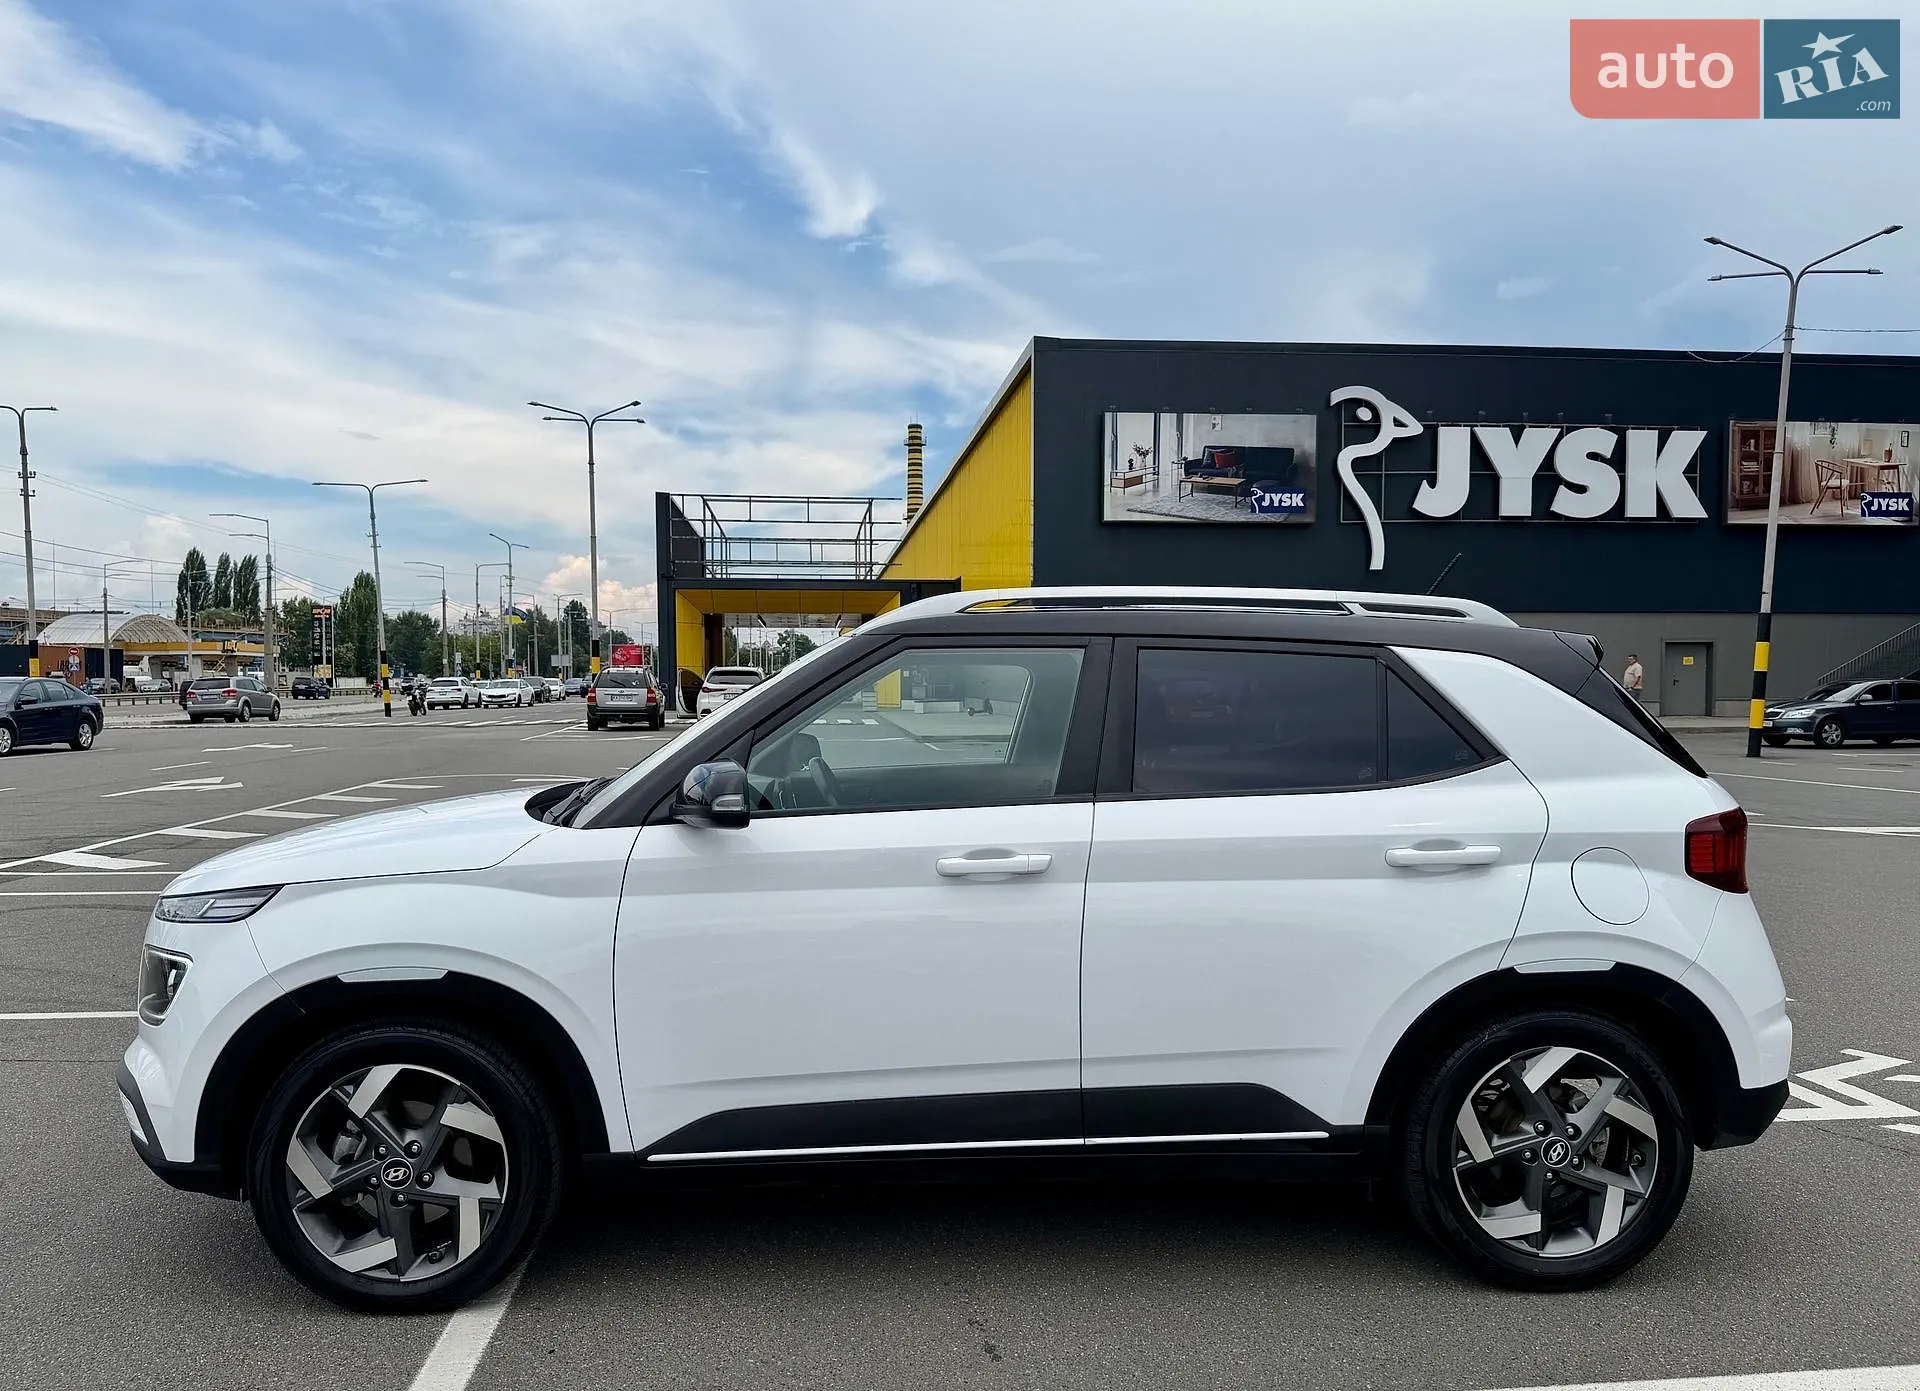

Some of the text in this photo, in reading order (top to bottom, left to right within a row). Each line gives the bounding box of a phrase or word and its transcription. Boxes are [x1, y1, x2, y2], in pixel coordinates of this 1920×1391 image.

[1412, 426, 1709, 519] JYSK
[1261, 493, 1305, 507] JYSK
[1870, 498, 1910, 511] JYSK
